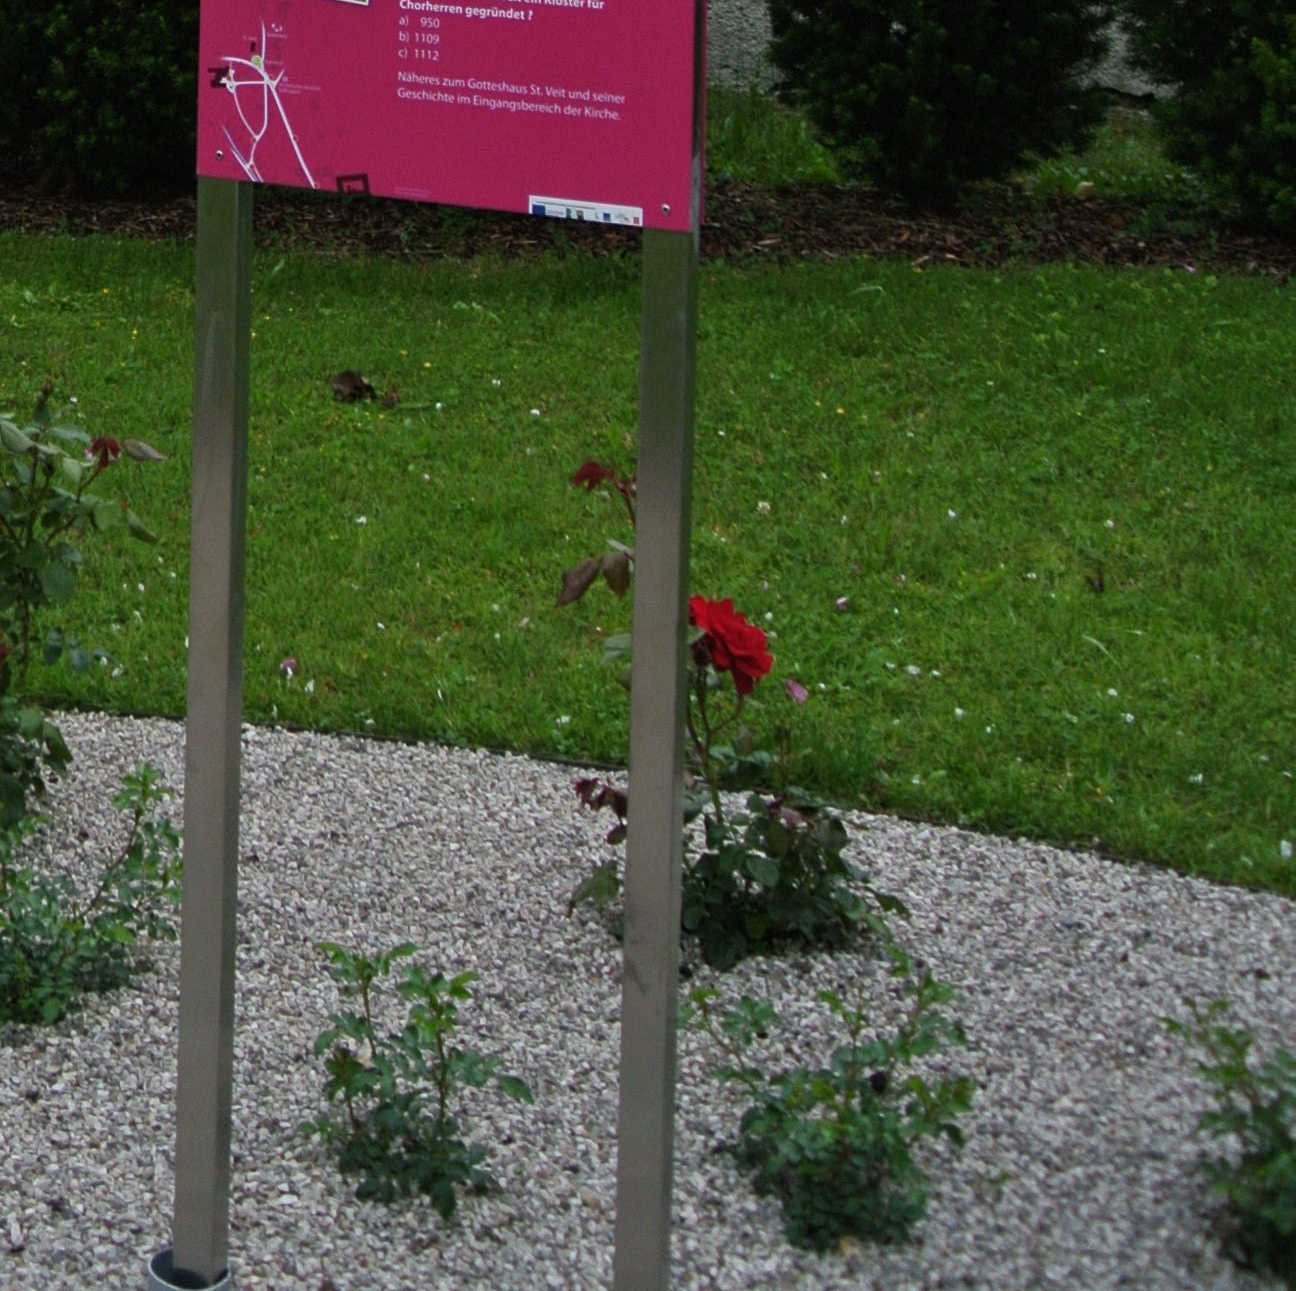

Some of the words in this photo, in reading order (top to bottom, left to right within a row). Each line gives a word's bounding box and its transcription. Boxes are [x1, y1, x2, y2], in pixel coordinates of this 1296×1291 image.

[465, 5, 524, 19] gegründet
[398, 15, 408, 26] a)
[420, 16, 439, 27] 950
[398, 31, 409, 41] b)
[415, 33, 439, 43] 1109
[398, 47, 407, 57] c)
[414, 48, 438, 60] 1112
[397, 87, 454, 100] Geschichte
[457, 94, 470, 103] im
[473, 94, 560, 112] Eingangsbereich
[563, 104, 581, 115] der
